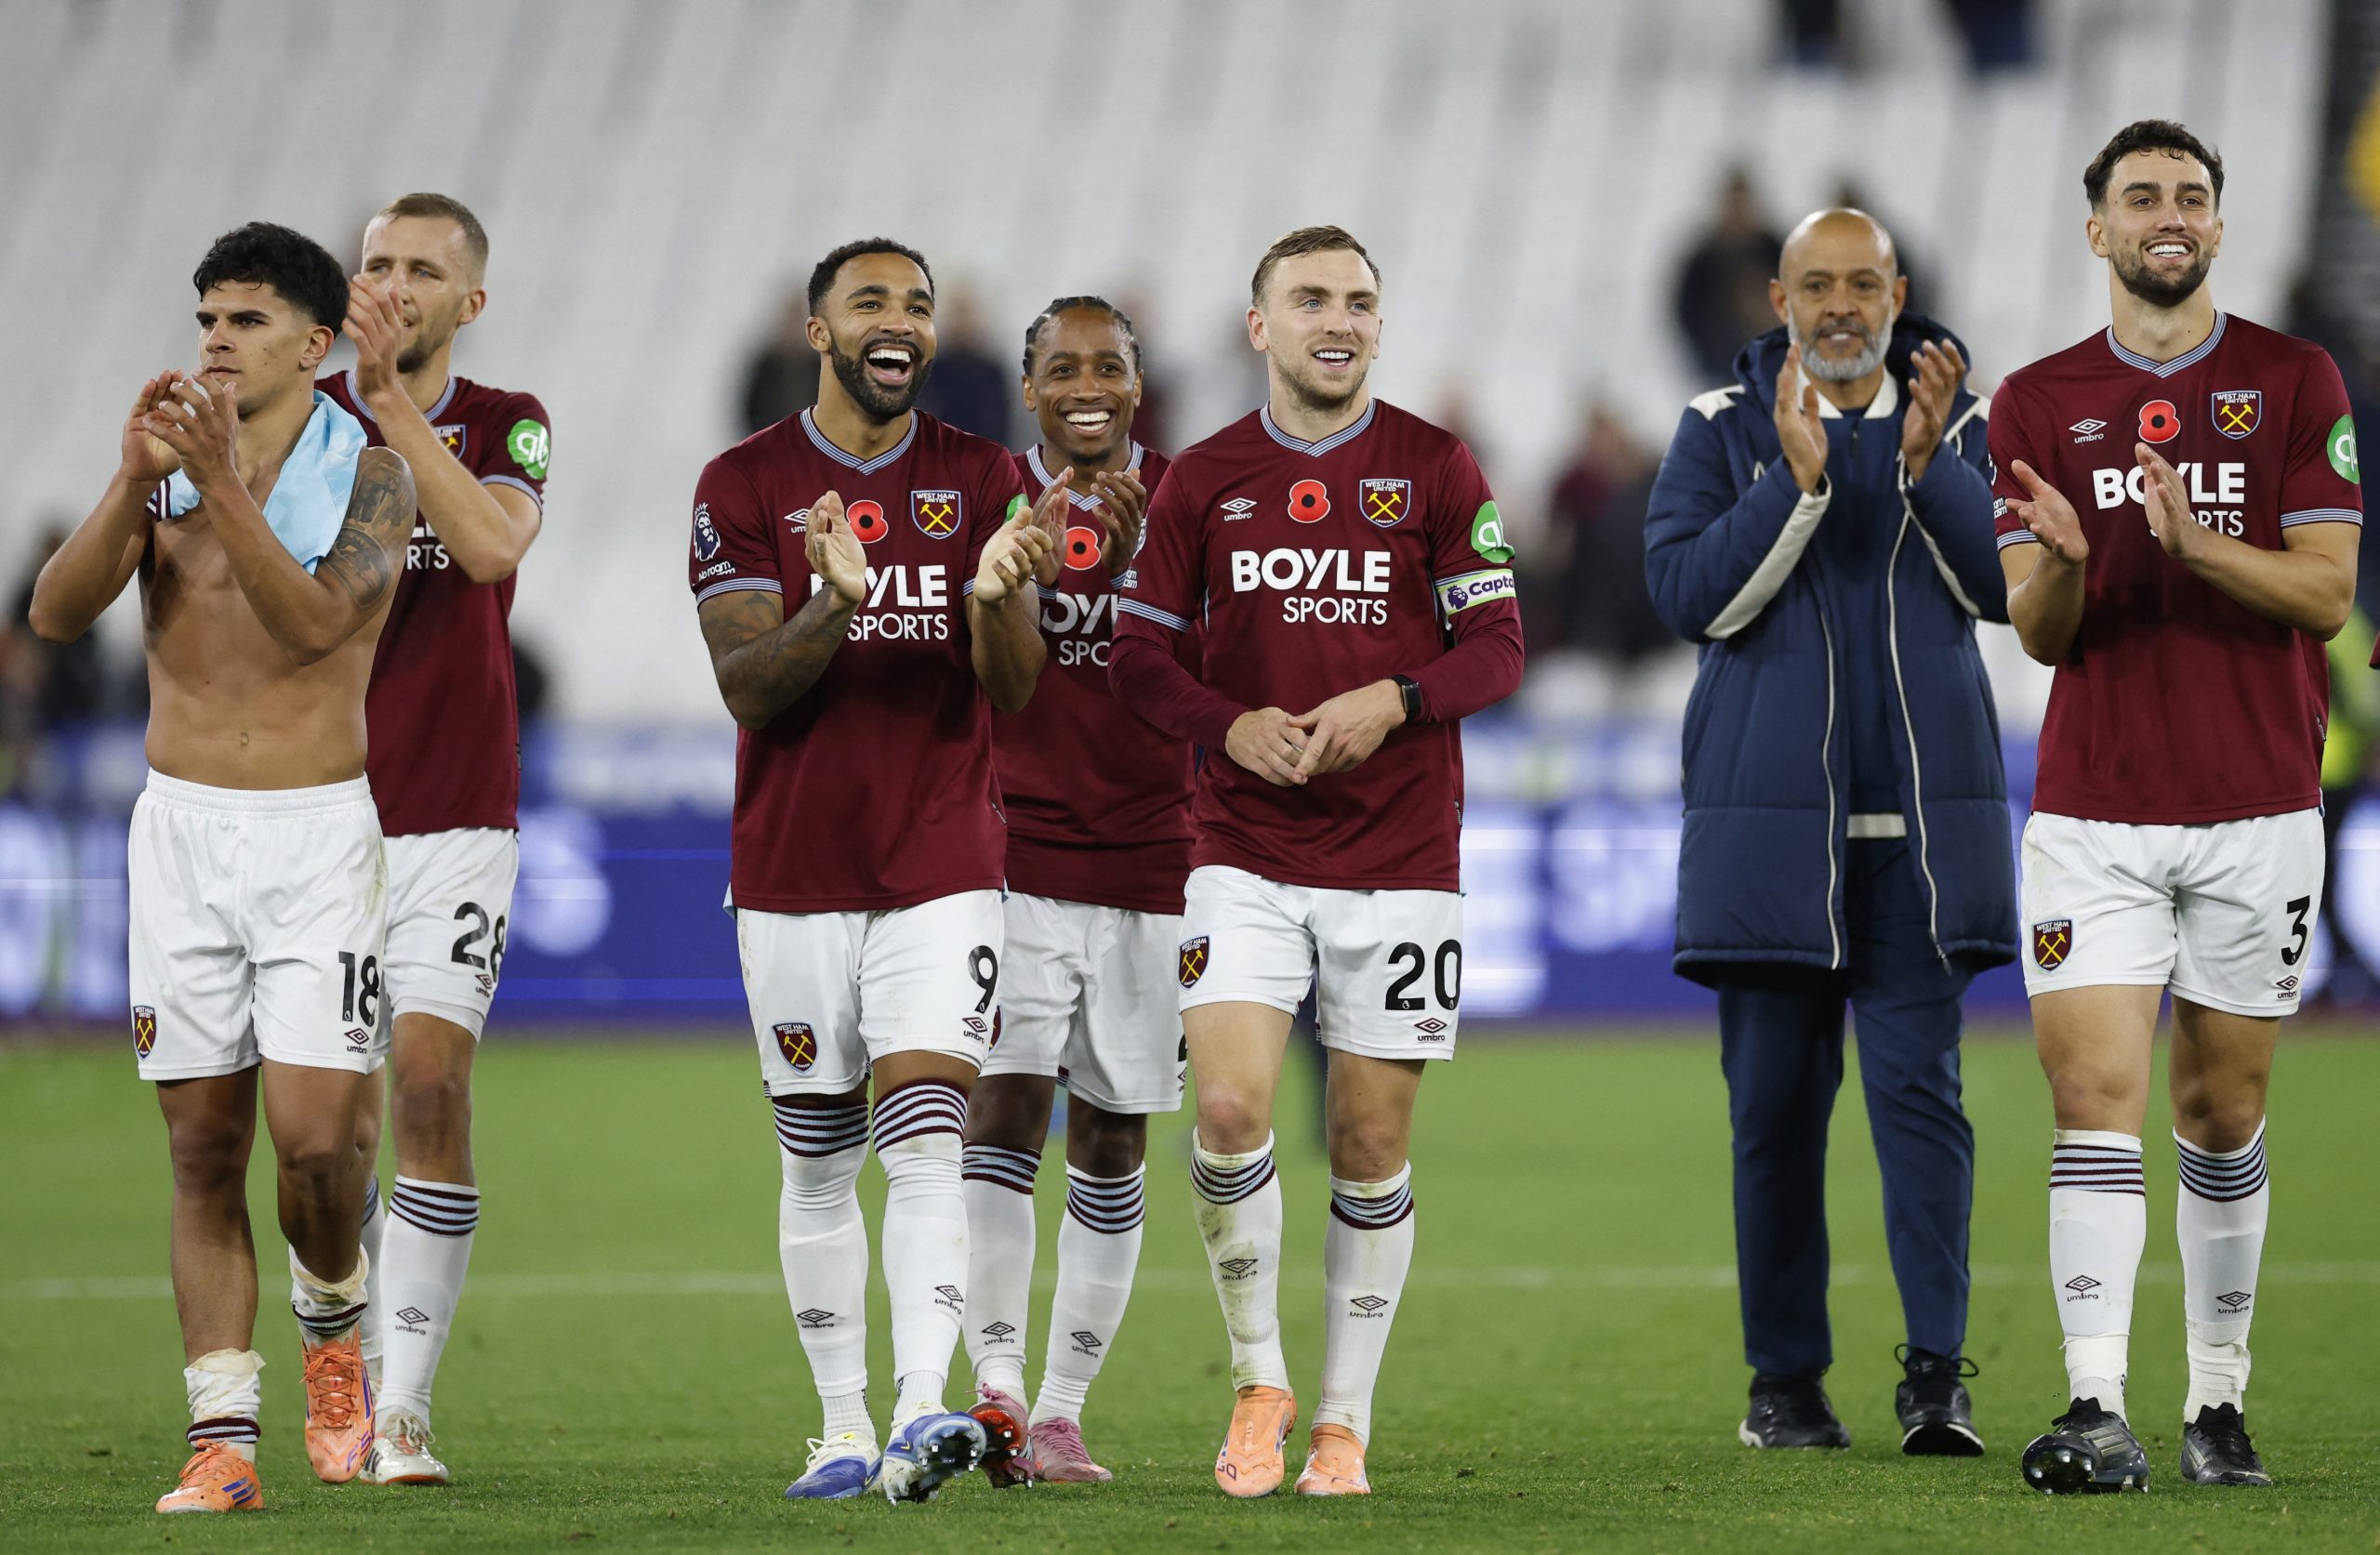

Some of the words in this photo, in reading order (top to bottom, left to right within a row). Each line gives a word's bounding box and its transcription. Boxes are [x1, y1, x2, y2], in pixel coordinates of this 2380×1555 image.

[2074, 433, 2104, 444] umbro
[1224, 512, 1252, 521] umbro
[406, 544, 450, 570] RTS
[1232, 547, 1391, 592] BOYLE
[811, 564, 948, 608] YLE
[1283, 596, 1388, 626] SPORTS
[847, 613, 948, 641] SPORTS
[2036, 922, 2053, 931] WEST
[2281, 894, 2310, 966] 3
[451, 901, 506, 983] 28
[968, 945, 998, 1014] 9
[1385, 939, 1462, 1010] 20
[338, 951, 379, 1027] 18
[934, 1298, 962, 1315] umbro
[2067, 1292, 2099, 1302] umbro
[2217, 1305, 2250, 1314] umbro
[395, 1324, 427, 1336] umbro
[985, 1337, 1015, 1346] umbro
[1071, 1346, 1099, 1358] umbro
